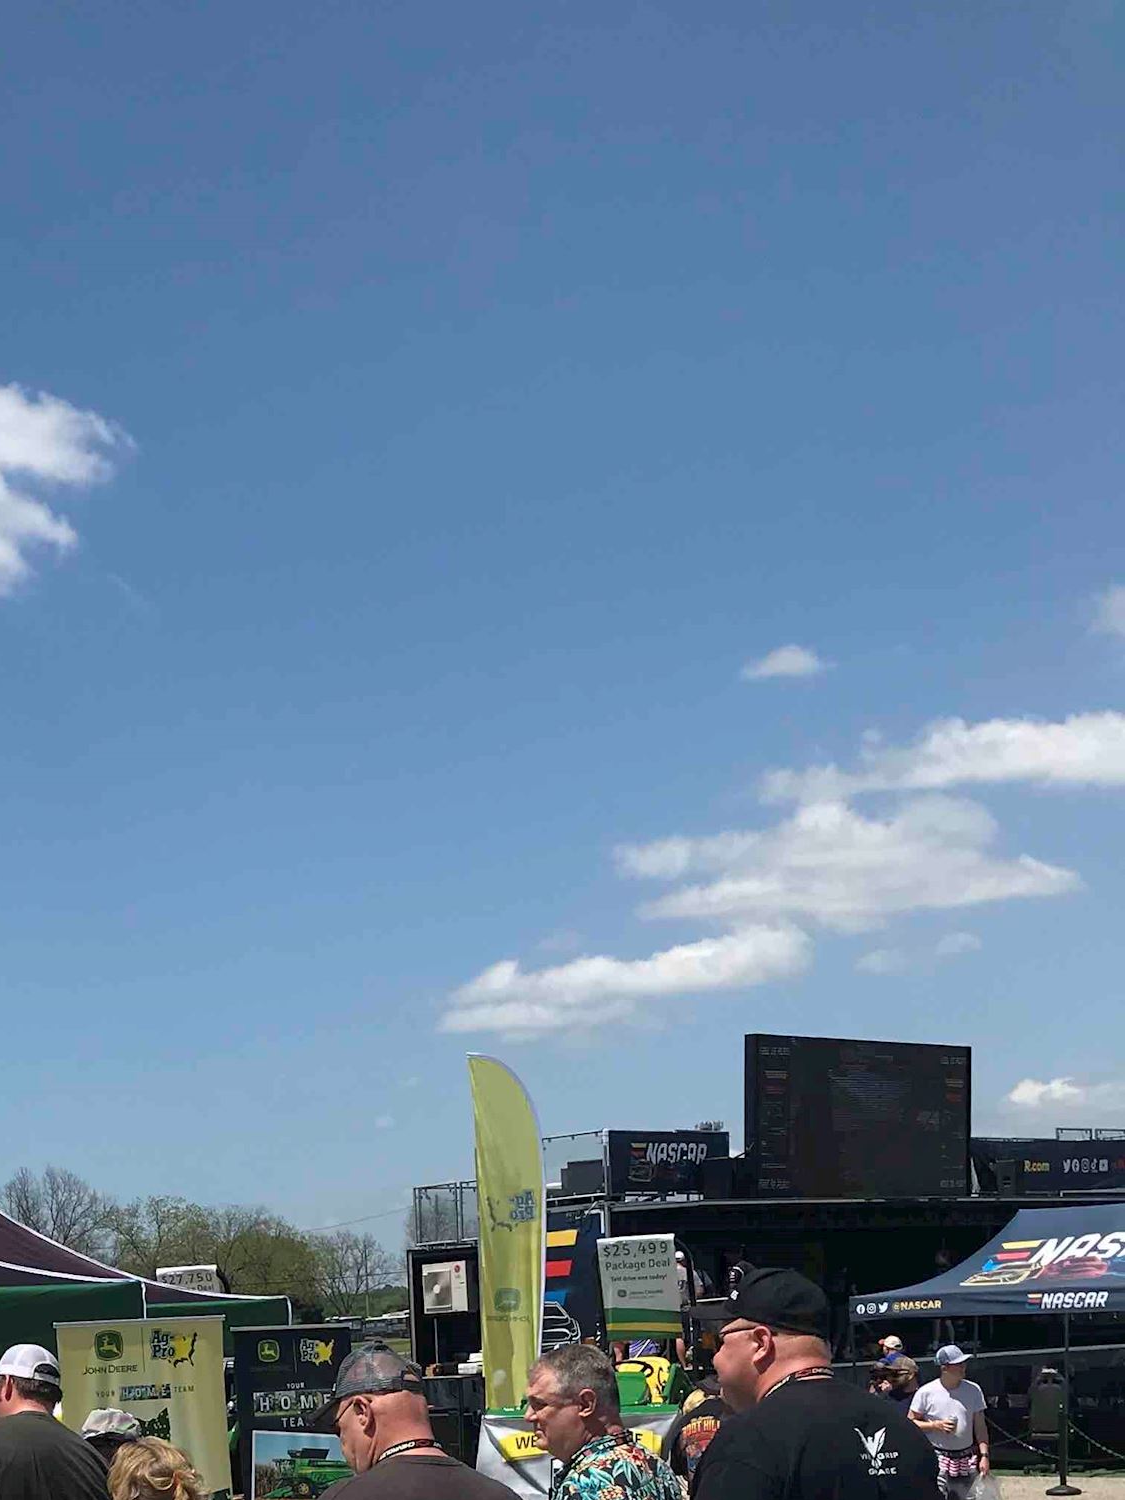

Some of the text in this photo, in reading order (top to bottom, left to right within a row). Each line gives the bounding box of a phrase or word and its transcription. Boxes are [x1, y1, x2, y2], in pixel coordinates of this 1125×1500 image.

[646, 1142, 708, 1165] NASCAR
[603, 1241, 668, 1259] $25,499
[1028, 1231, 1125, 1266] NAS
[605, 1257, 671, 1272] Package Deal
[893, 1299, 942, 1312] @NASCAR
[1041, 1291, 1109, 1309] NASCAR
[151, 1329, 175, 1347] Ag-
[151, 1345, 175, 1359] Pro
[83, 1364, 138, 1375] JOHN DEERE
[174, 1385, 195, 1393] TEAM
[281, 1416, 309, 1428] TEA
